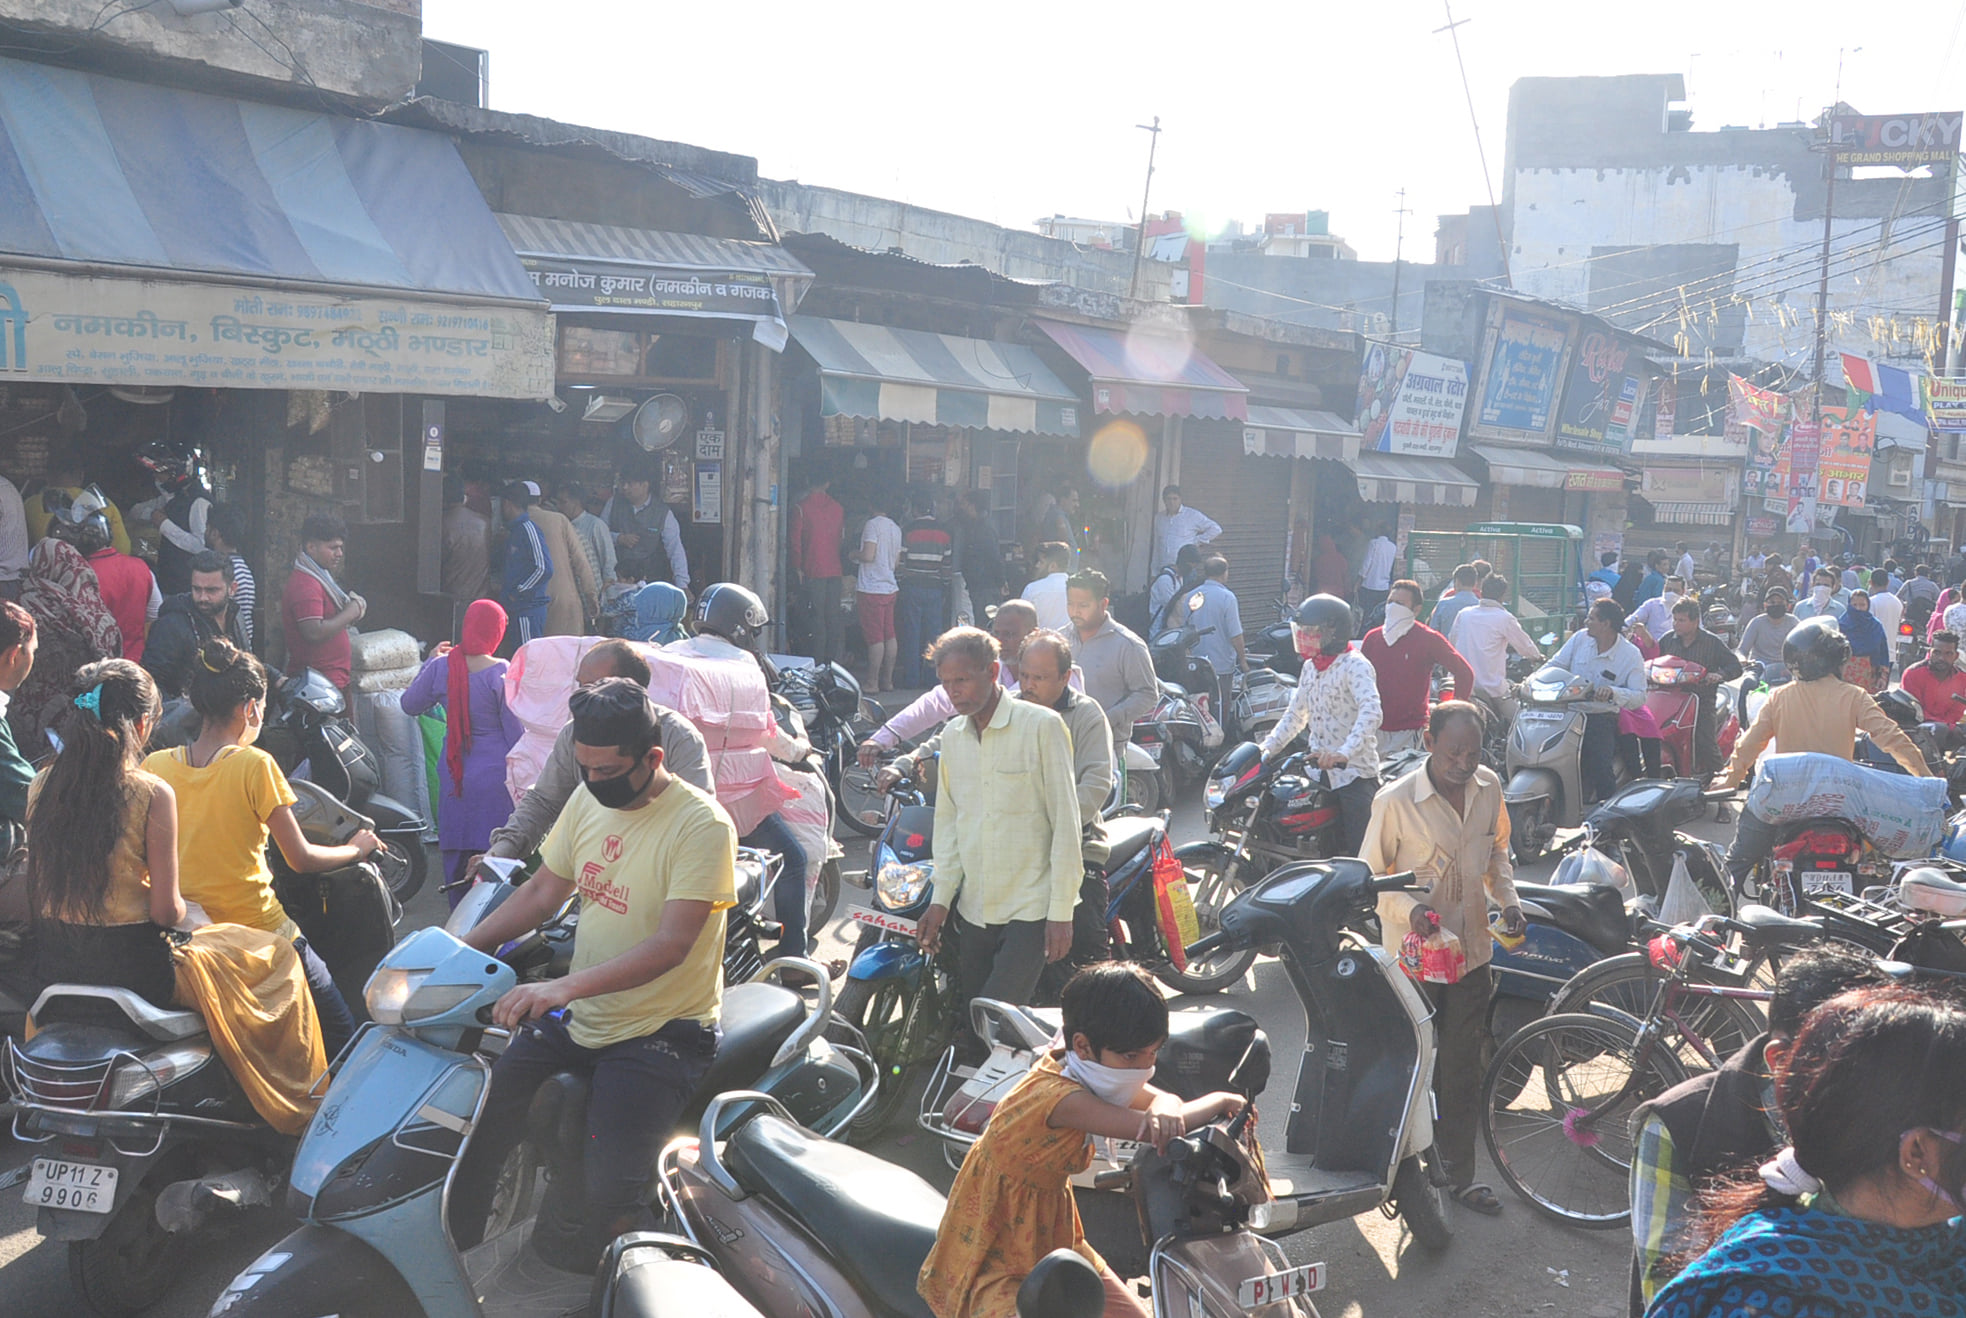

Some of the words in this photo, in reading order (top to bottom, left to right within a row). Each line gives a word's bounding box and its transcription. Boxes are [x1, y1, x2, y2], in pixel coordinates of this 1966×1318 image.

[1836, 153, 1848, 163] HE
[1850, 152, 1882, 163] GRAND
[545, 268, 595, 289] मनोज
[600, 275, 646, 296] कुमार
[53, 310, 197, 344] नमकीन,
[210, 315, 321, 354] बिस्कुट,
[408, 335, 489, 357] भण्डार
[1406, 373, 1445, 393] अग्रवाल
[1447, 376, 1467, 398] स्टोर
[1932, 401, 1959, 409] PLAY
[699, 433, 721, 444] एक
[699, 444, 721, 458] दाम
[45, 1161, 86, 1184] UP11
[90, 1168, 102, 1187] Z
[41, 1186, 98, 1210] 9906
